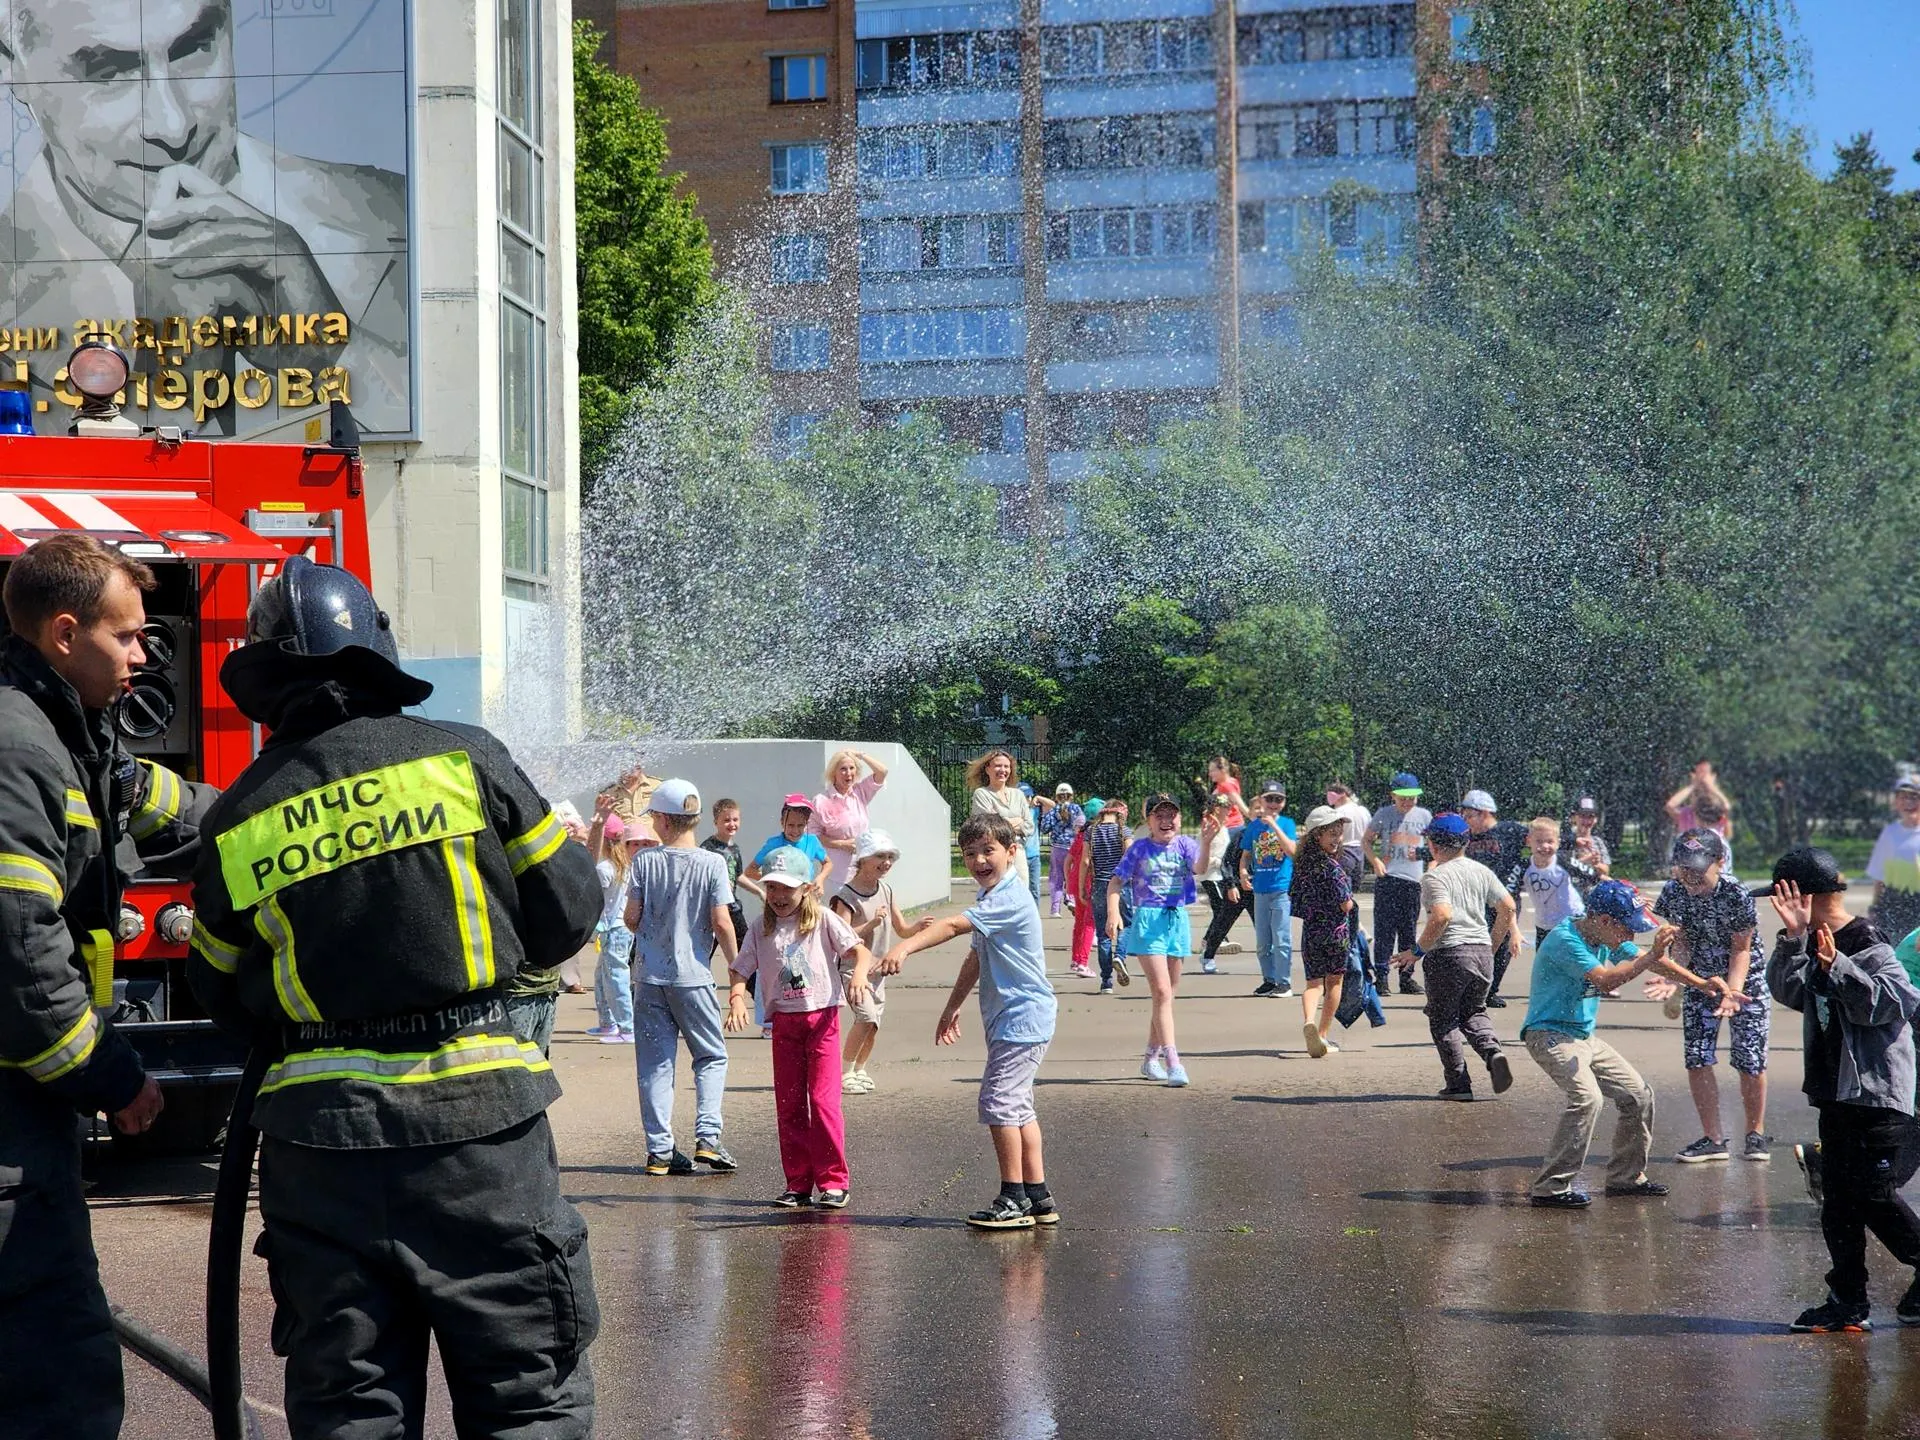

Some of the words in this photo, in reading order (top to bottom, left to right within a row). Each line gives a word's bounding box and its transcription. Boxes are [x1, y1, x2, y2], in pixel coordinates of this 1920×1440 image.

[73, 311, 348, 355] академика
[282, 778, 383, 833] МЧС
[251, 802, 448, 891] РОССИИ
[300, 1021, 336, 1040] ИНВ
